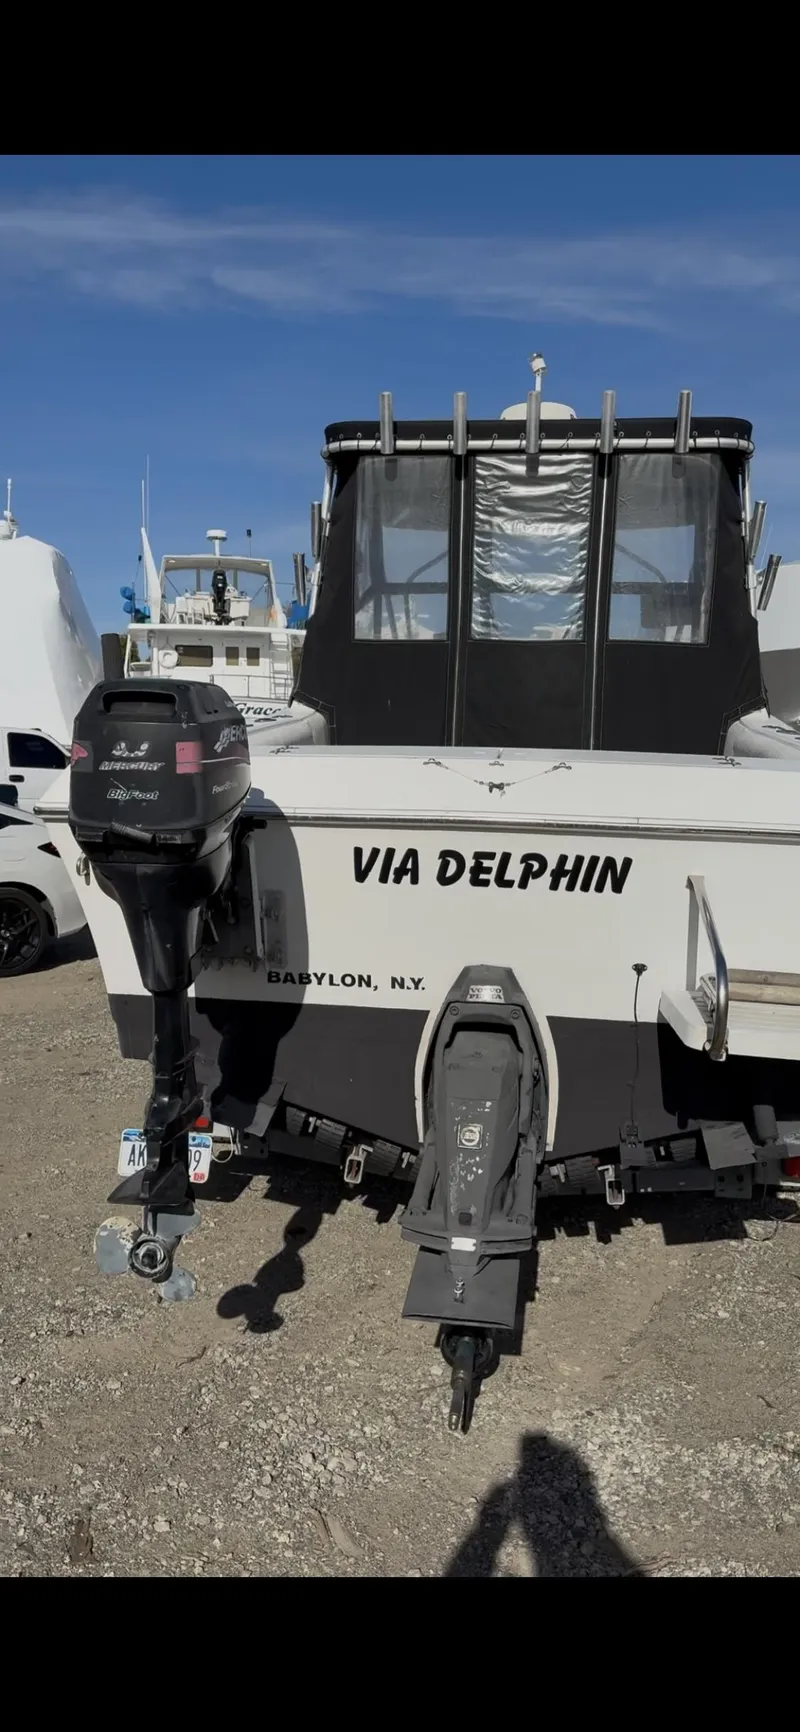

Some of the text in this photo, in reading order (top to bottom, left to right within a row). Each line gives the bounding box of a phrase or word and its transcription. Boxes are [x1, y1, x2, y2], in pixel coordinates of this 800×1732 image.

[98, 761, 166, 771] MERCURY
[106, 788, 160, 801] BigFoot
[353, 846, 633, 894] VIA DELPHIN
[267, 970, 426, 991] BABYLON, N.Y.
